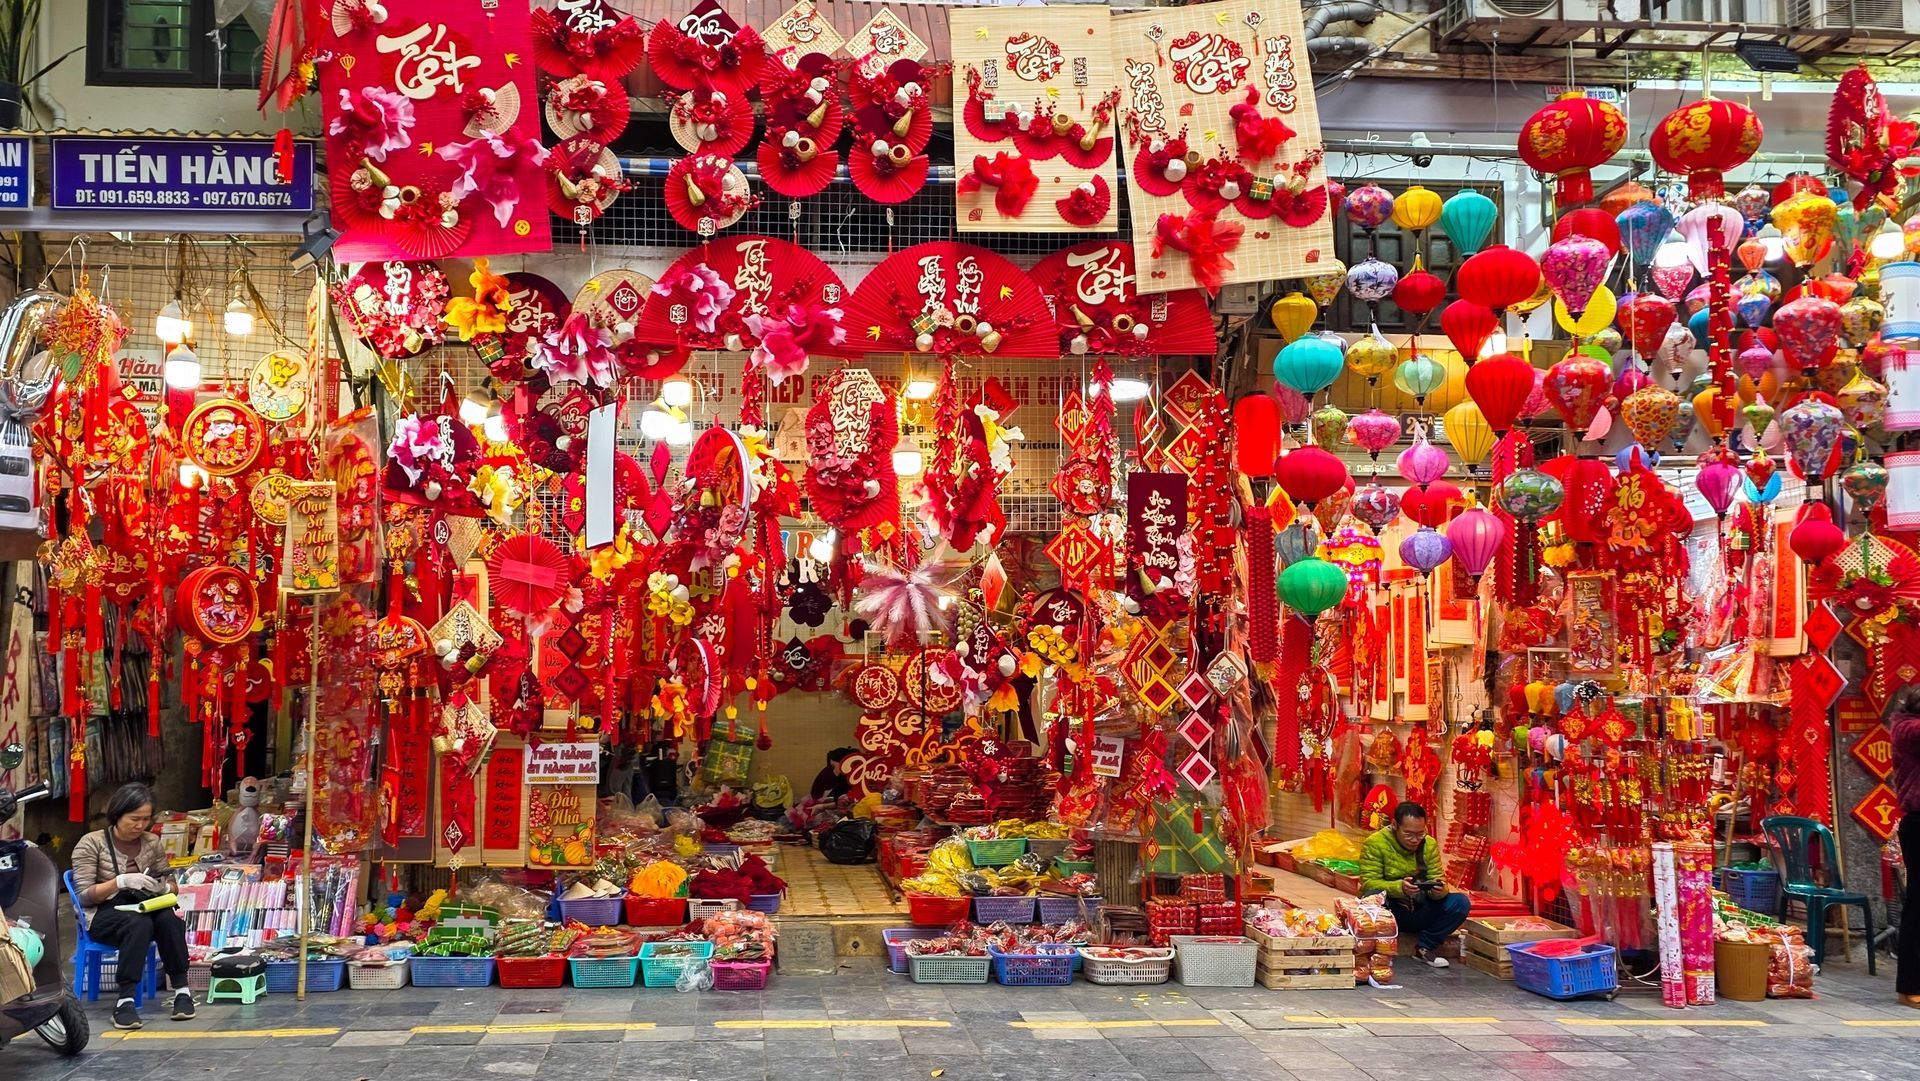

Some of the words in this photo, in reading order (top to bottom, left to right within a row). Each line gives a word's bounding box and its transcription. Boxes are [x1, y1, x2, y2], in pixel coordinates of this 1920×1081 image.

[870, 25, 908, 54] Tết
[376, 22, 482, 99] Tết
[1005, 35, 1065, 81] Tết
[1169, 33, 1250, 94] Tết
[79, 145, 166, 184] TIẾN
[75, 189, 96, 203] ĐT:
[100, 190, 190, 205] 091.659.8833
[203, 191, 292, 206] 097.670.6674
[736, 239, 773, 276] Tết
[1067, 247, 1136, 304] Tết
[119, 356, 165, 375] Hằn
[832, 380, 871, 414] Tết
[298, 500, 328, 516] Vạn
[307, 516, 325, 533] Sự
[1048, 600, 1077, 622] Tết
[860, 715, 900, 754] Tết
[1874, 798, 1896, 825] Ý
